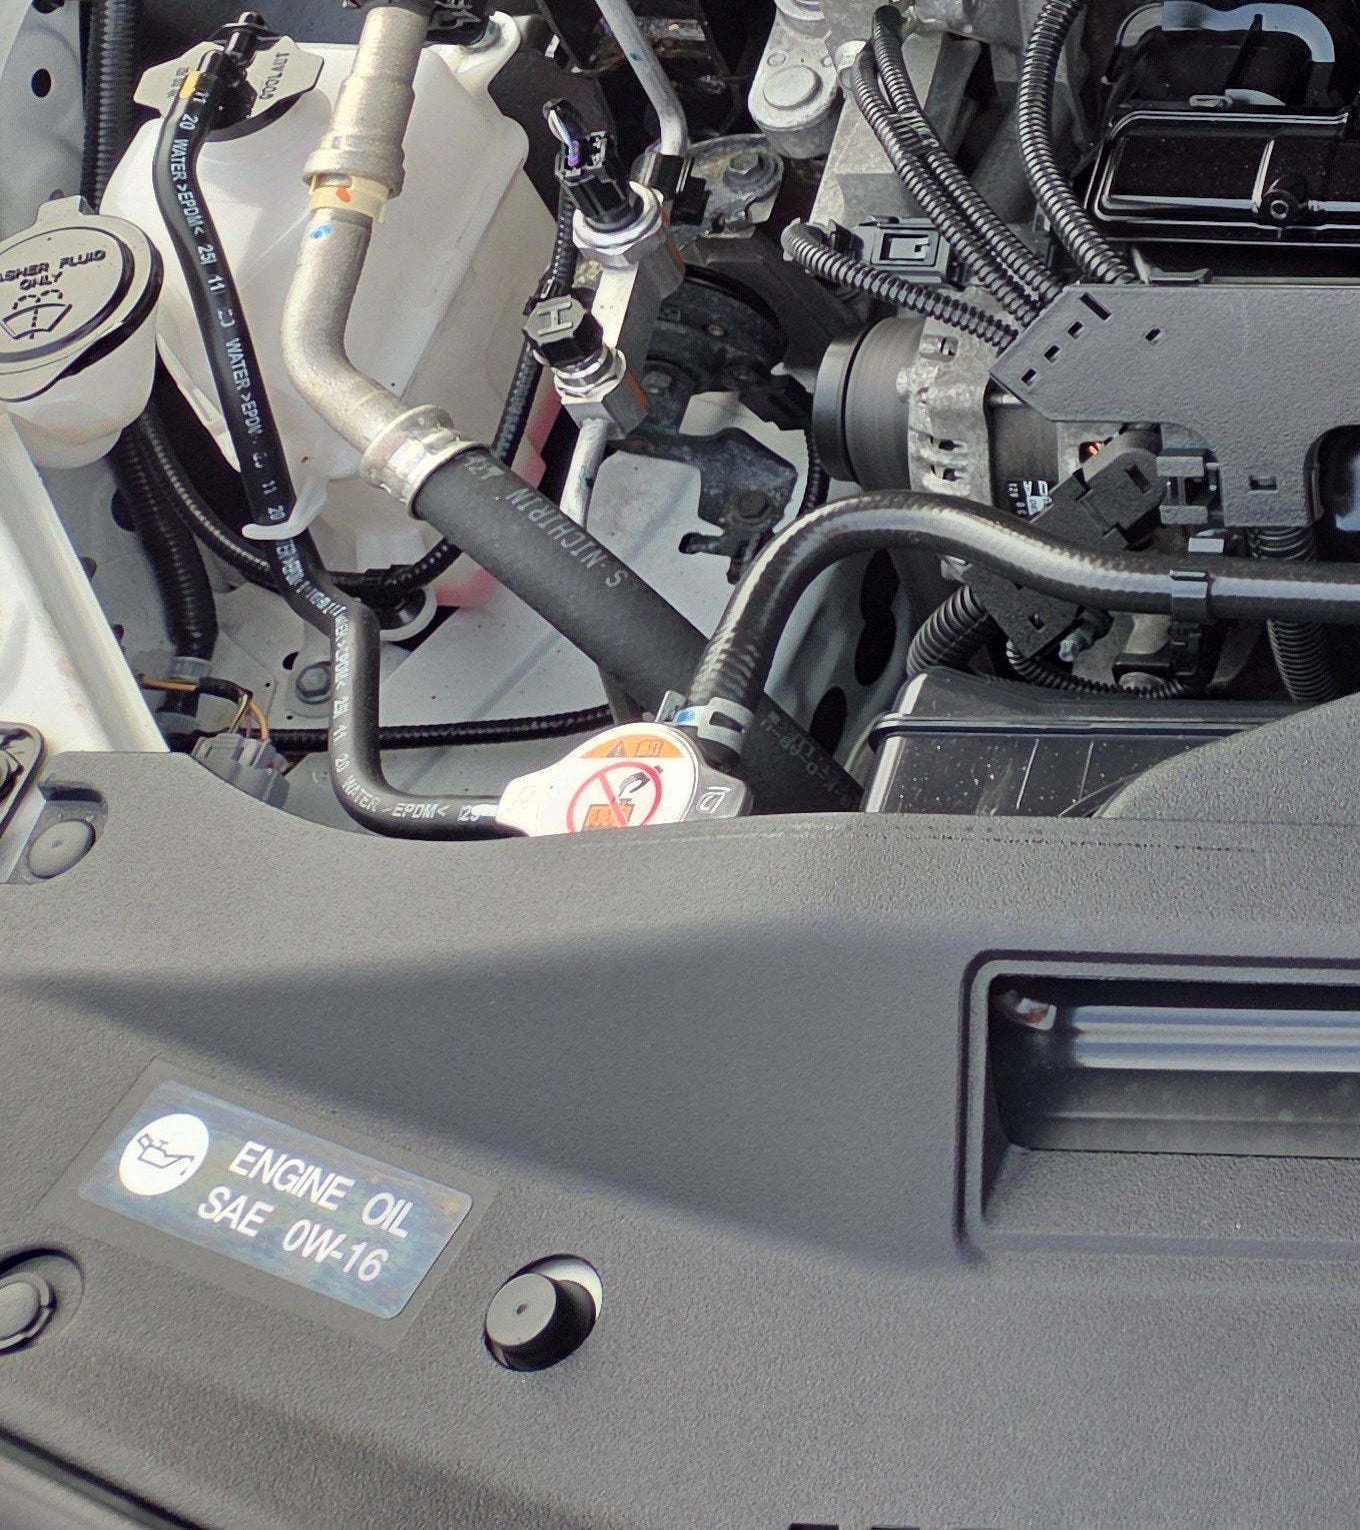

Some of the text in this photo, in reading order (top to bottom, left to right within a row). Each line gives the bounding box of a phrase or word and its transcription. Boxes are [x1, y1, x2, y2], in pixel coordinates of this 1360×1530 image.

[259, 51, 290, 100] COOLANT
[179, 113, 199, 130] 20
[170, 138, 190, 182] WATER
[59, 250, 106, 269] FLUID
[20, 271, 63, 290] ONLY
[226, 337, 250, 391] WATER
[335, 753, 351, 773] 20
[342, 775, 381, 812] WATER
[228, 1140, 413, 1238] ENGINE OIL
[198, 1183, 390, 1282] SAE 0W-16
